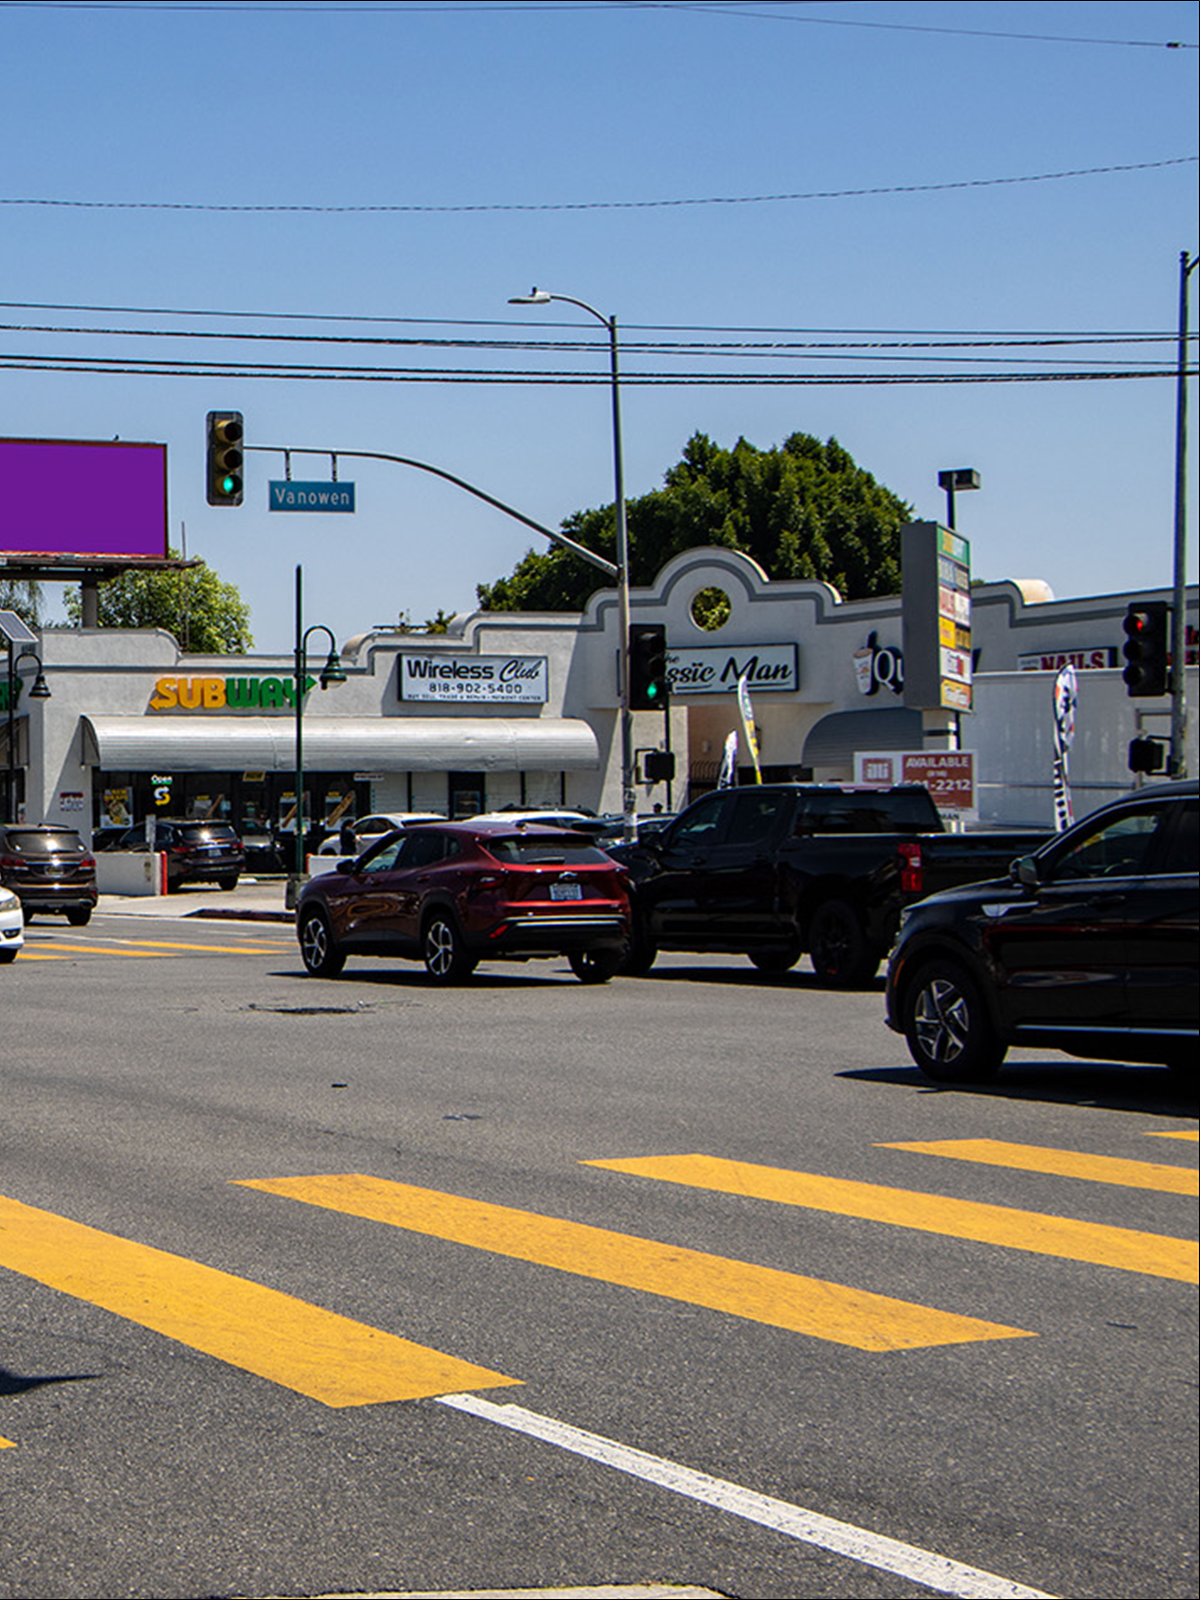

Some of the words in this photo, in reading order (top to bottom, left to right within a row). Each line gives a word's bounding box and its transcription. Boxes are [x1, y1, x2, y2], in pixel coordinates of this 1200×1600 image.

[274, 486, 350, 506] Vanowen
[406, 659, 495, 680] Wireless
[500, 659, 543, 683] Club
[719, 655, 793, 683] Man
[150, 675, 317, 711] SUBWAY
[906, 757, 970, 769] AVAILABLE
[150, 774, 173, 786] Open
